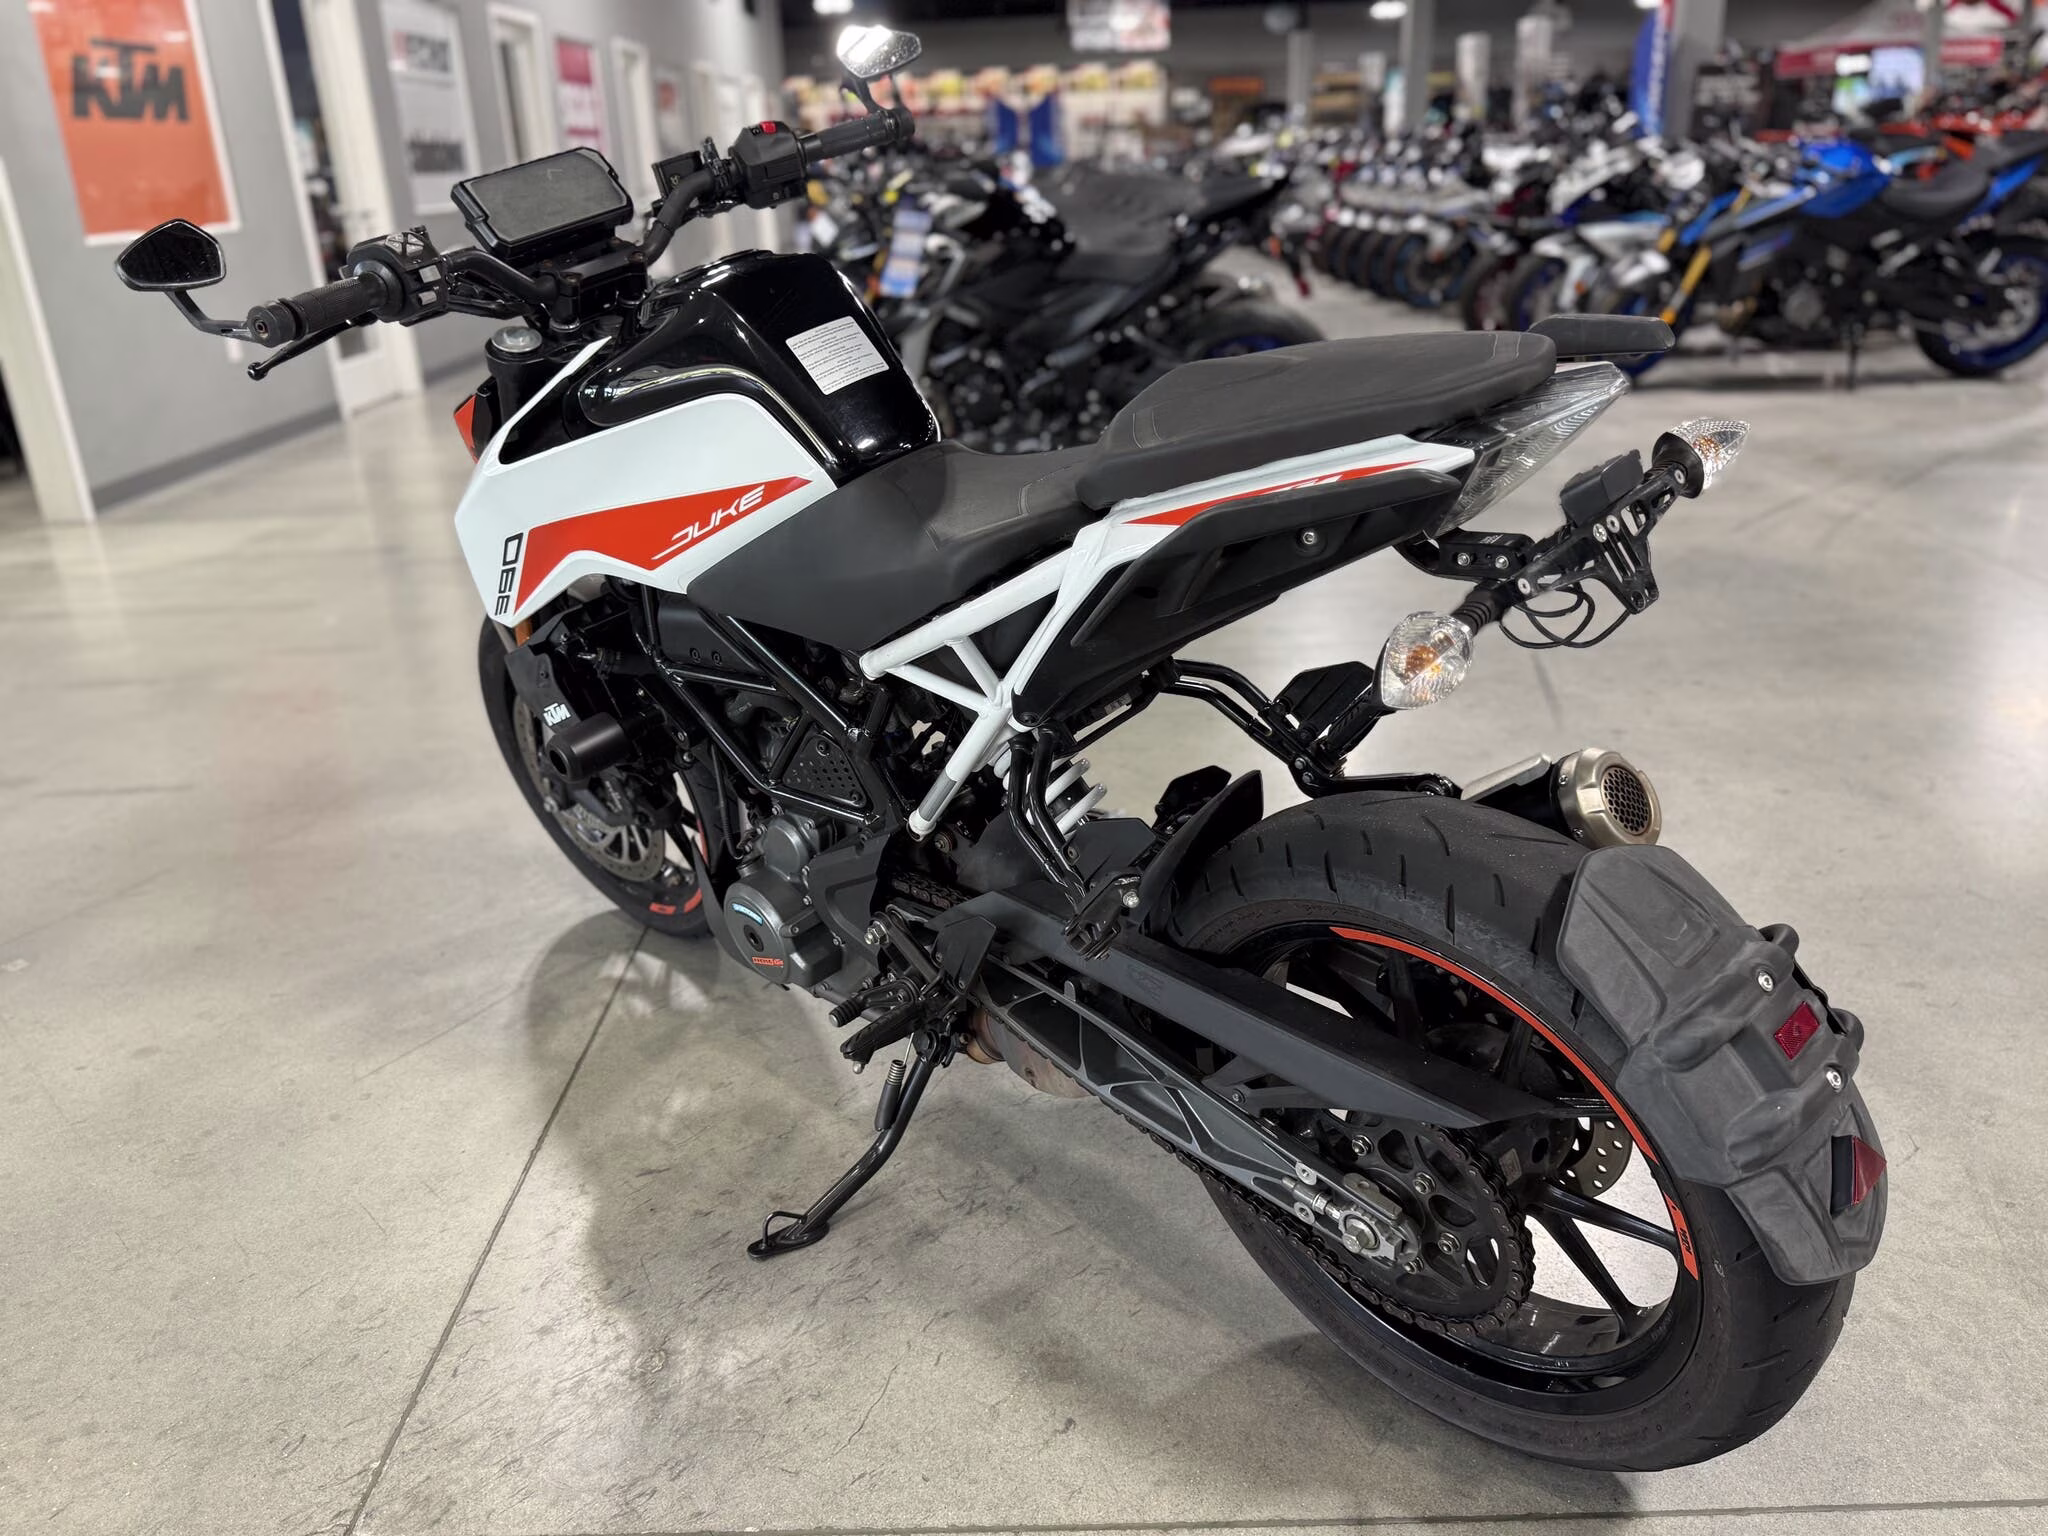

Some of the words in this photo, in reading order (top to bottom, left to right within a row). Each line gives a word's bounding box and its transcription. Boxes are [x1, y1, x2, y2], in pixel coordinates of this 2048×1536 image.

[72, 37, 189, 121] KTM
[651, 484, 765, 560] DUKE
[494, 532, 523, 616] 390
[542, 702, 571, 727] KTM
